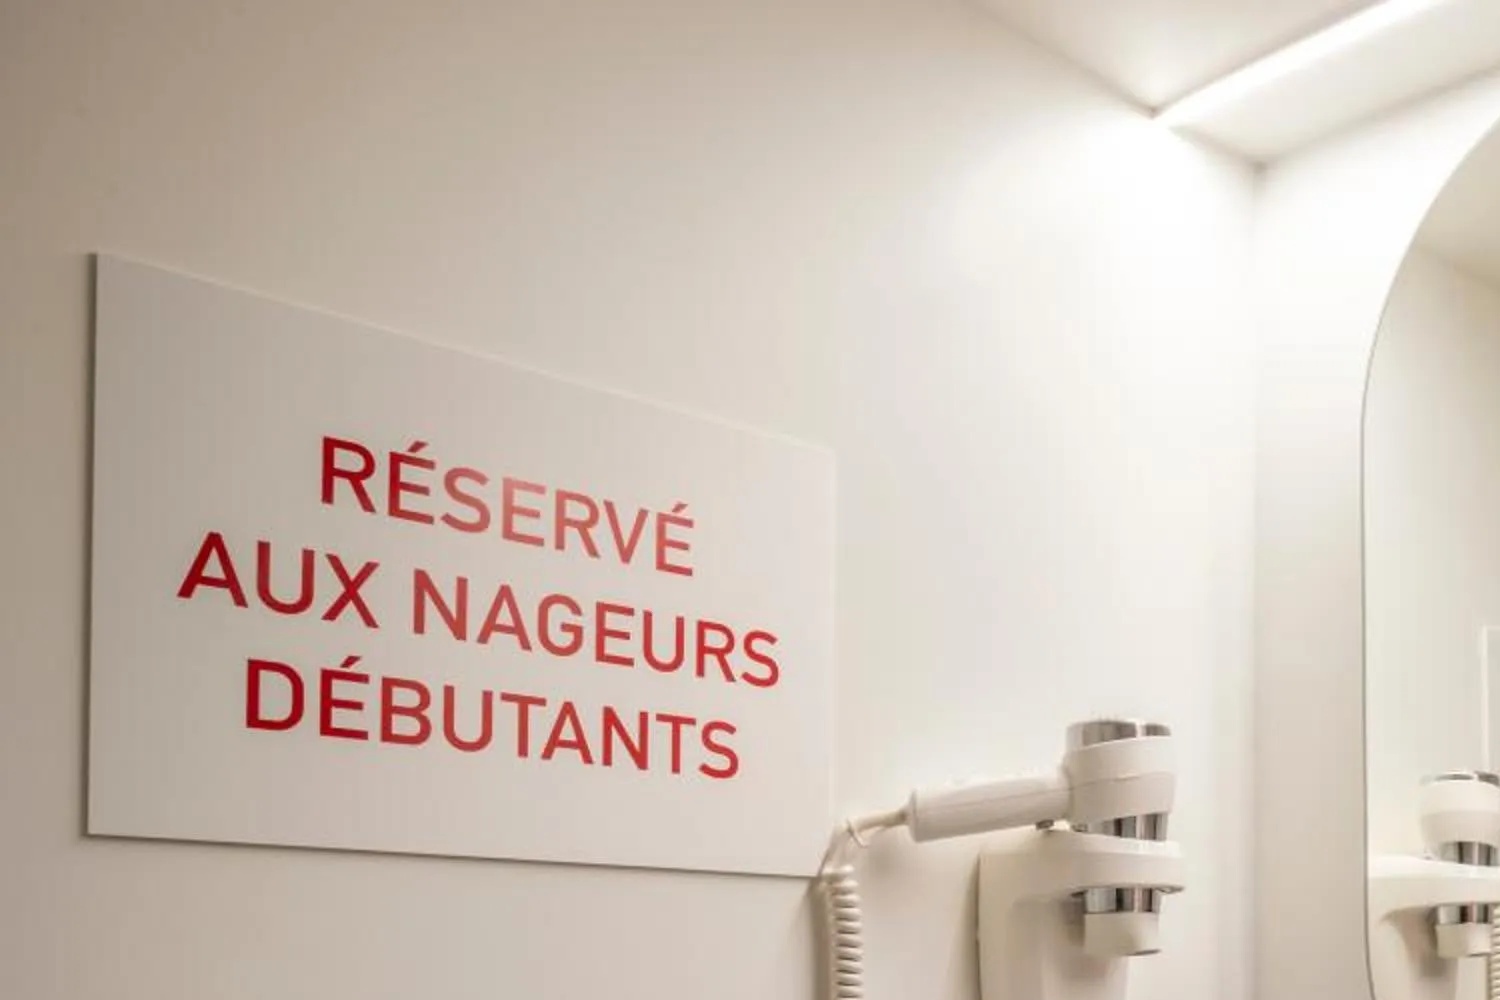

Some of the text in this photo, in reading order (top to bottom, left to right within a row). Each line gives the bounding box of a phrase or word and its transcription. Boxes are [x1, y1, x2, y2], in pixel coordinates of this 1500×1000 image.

[320, 436, 695, 577] RÉSERVÉ
[177, 531, 781, 689] AUX NAGEURS
[245, 655, 739, 779] DÉBUTANTS
